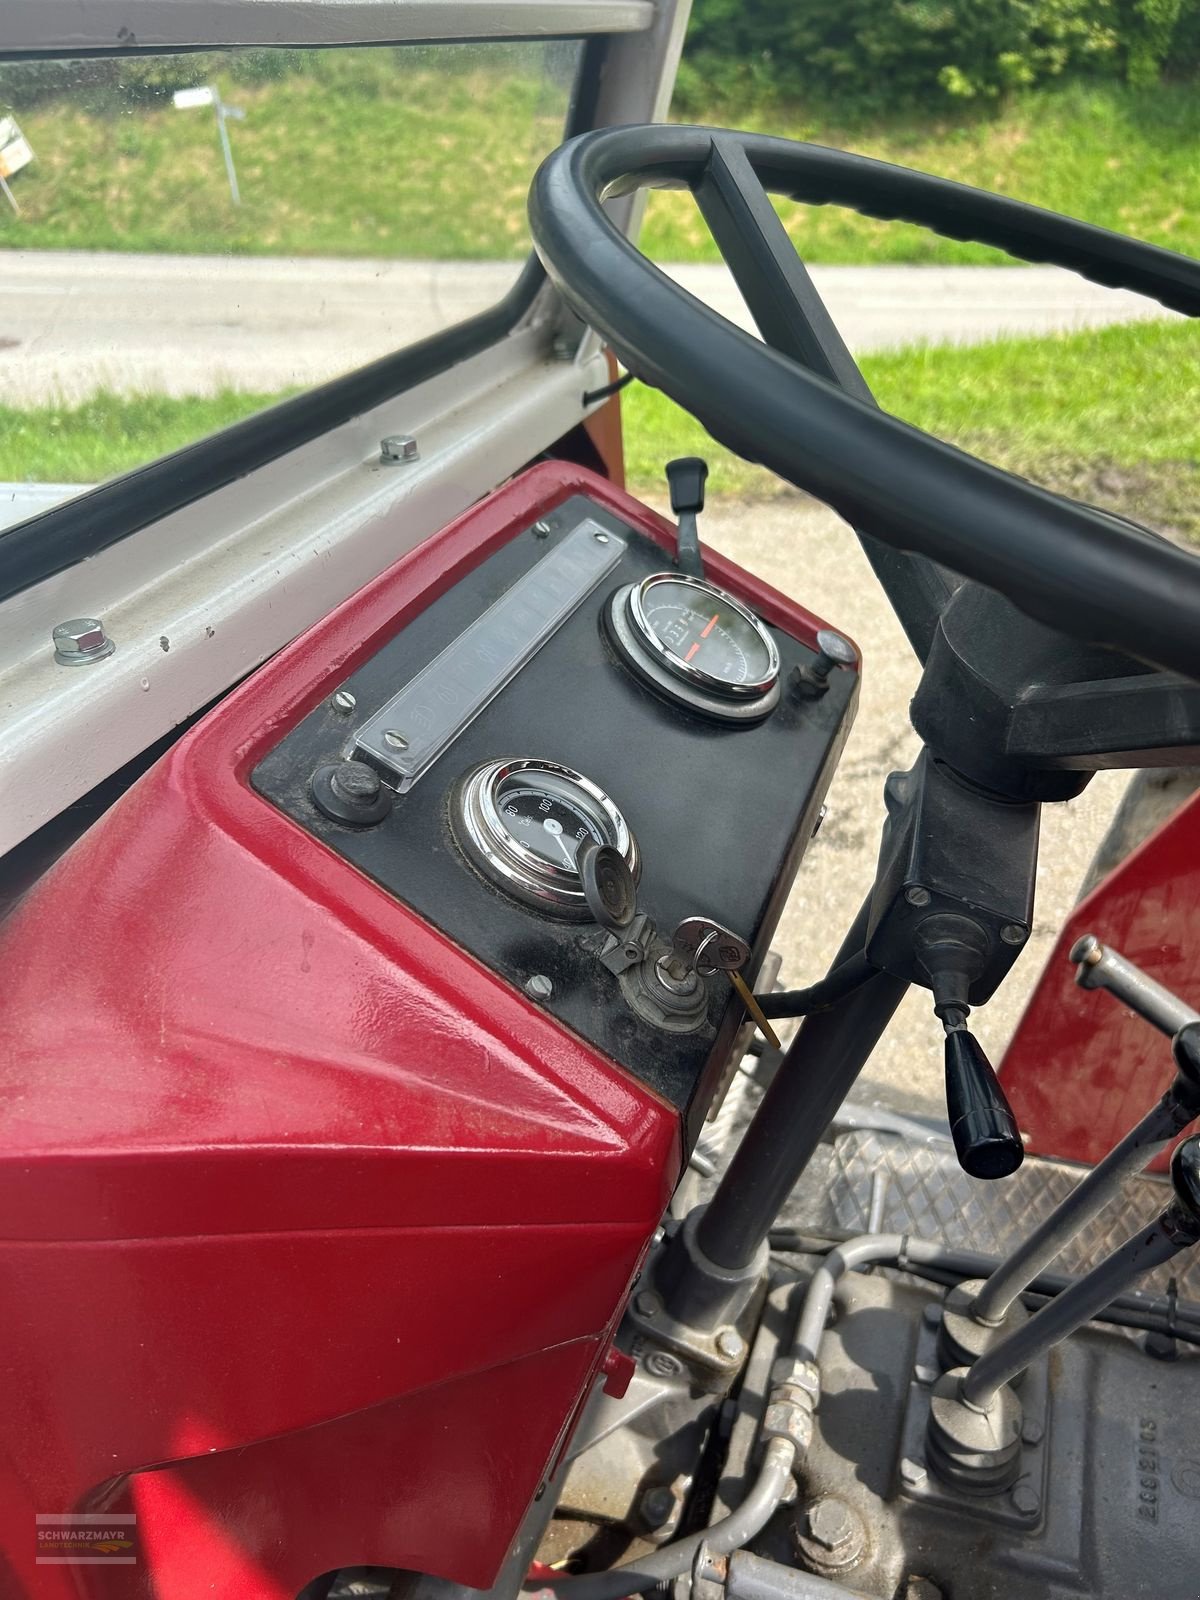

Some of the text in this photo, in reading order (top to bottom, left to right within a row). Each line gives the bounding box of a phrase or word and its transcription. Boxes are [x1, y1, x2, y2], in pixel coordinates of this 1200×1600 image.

[504, 804, 519, 818] 80
[538, 798, 554, 813] 100
[575, 827, 589, 841] 120
